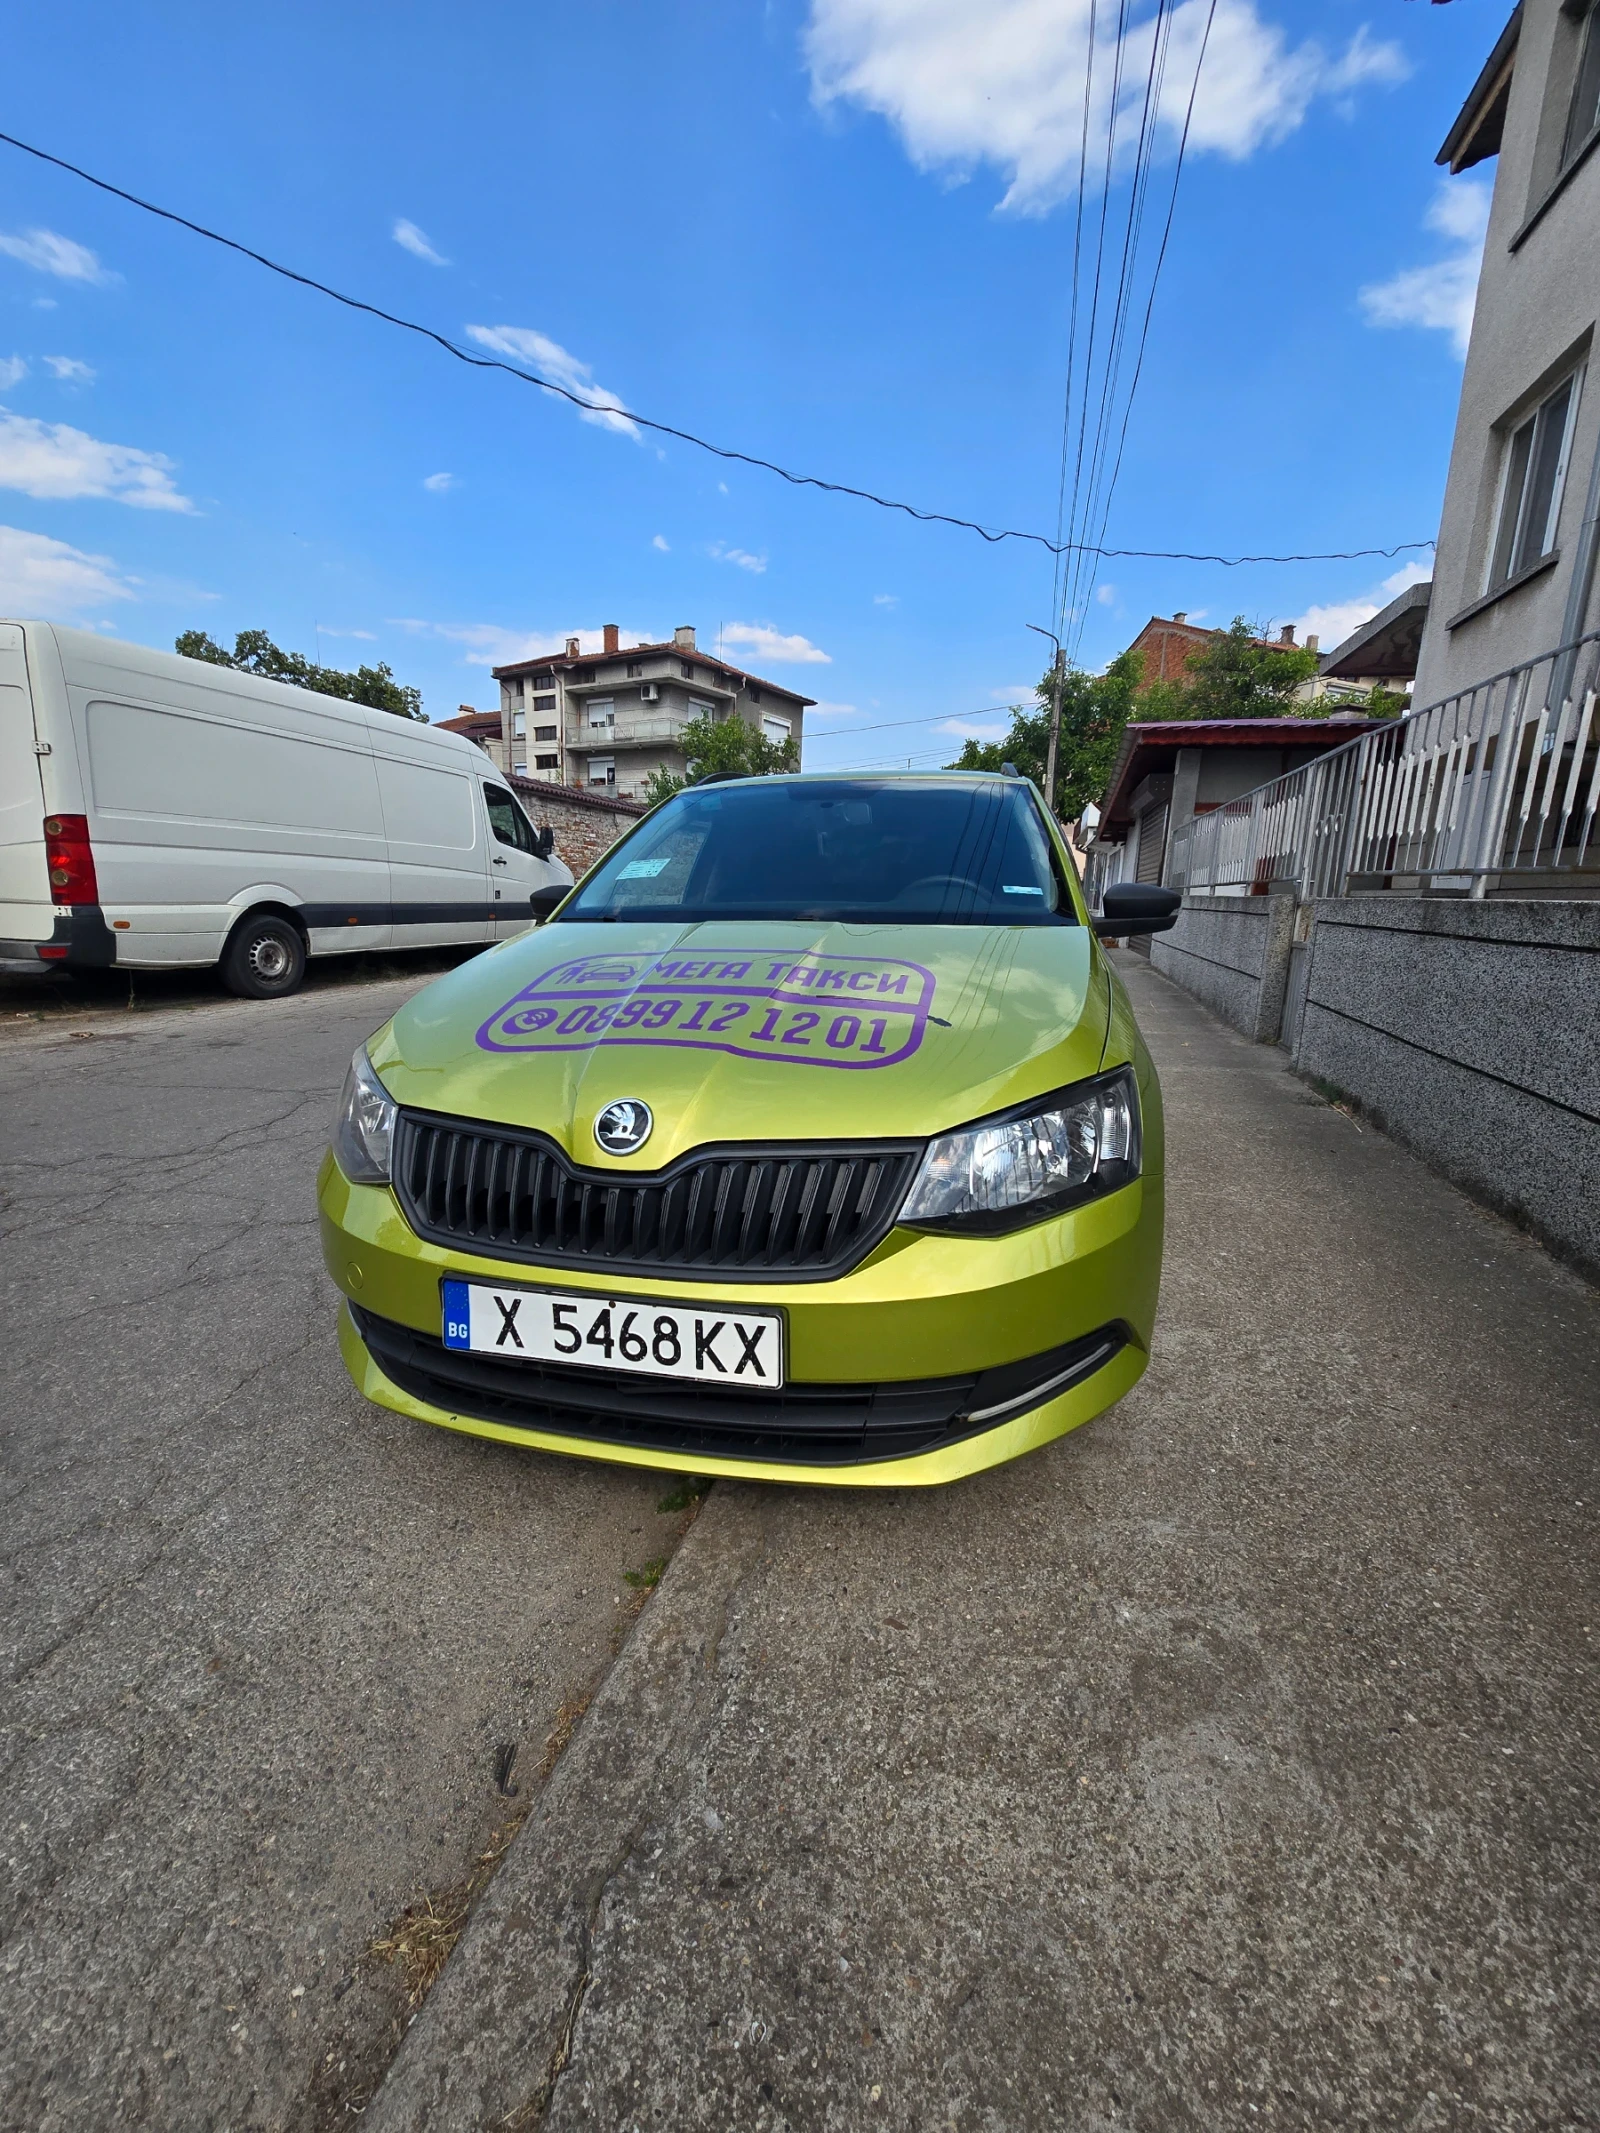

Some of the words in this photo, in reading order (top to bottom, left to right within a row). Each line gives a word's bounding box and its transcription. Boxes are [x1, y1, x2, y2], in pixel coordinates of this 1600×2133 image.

[640, 961, 752, 981] МЕГА
[766, 962, 910, 995] ТАКСИ
[555, 1000, 680, 1034] 0899
[677, 1001, 751, 1032] 12
[750, 1008, 822, 1045] 12
[824, 1020, 887, 1054] 01
[448, 1322, 468, 1339] BG
[552, 1302, 681, 1366] 5468
